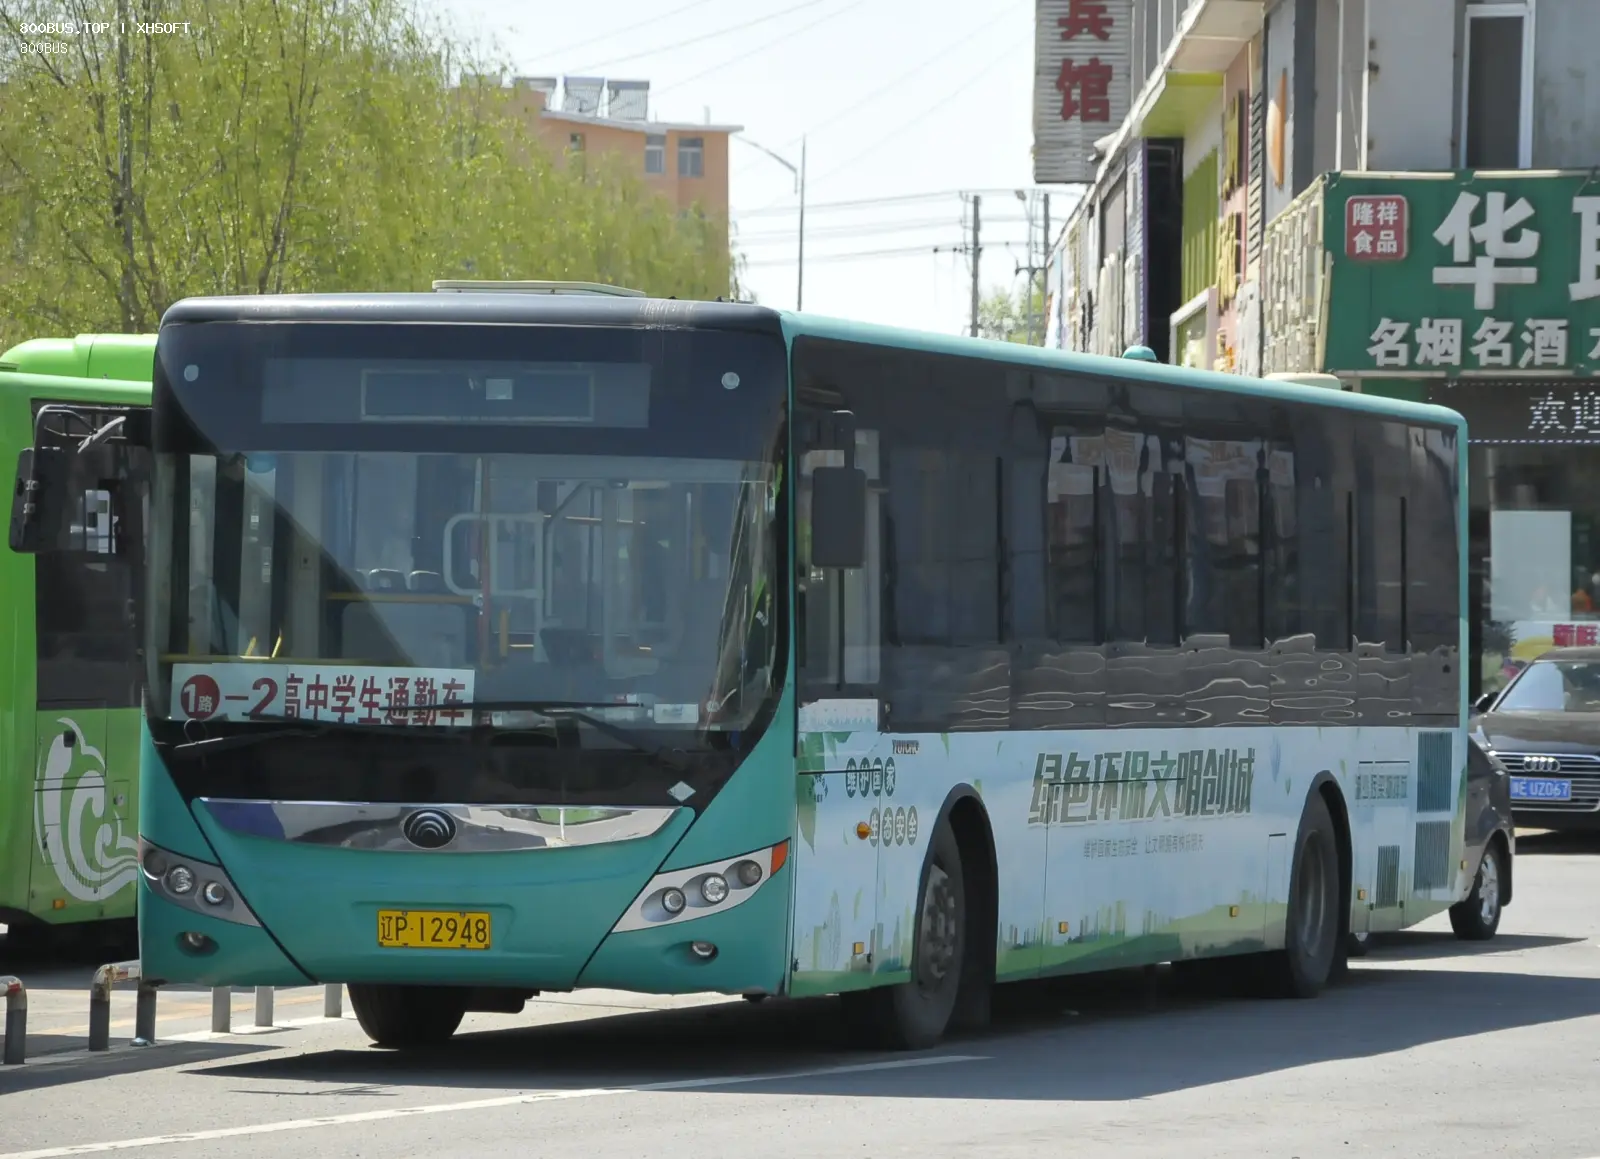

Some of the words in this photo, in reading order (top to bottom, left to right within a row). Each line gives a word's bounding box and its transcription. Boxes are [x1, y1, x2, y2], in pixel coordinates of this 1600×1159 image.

[1352, 202, 1399, 226] 隆祥
[1352, 230, 1398, 254] 食品
[1366, 317, 1569, 368] 名烟名酒
[846, 760, 895, 796] 维护国家
[1028, 747, 1256, 824] 绿色环保文明创城
[869, 808, 918, 844] 生态安全
